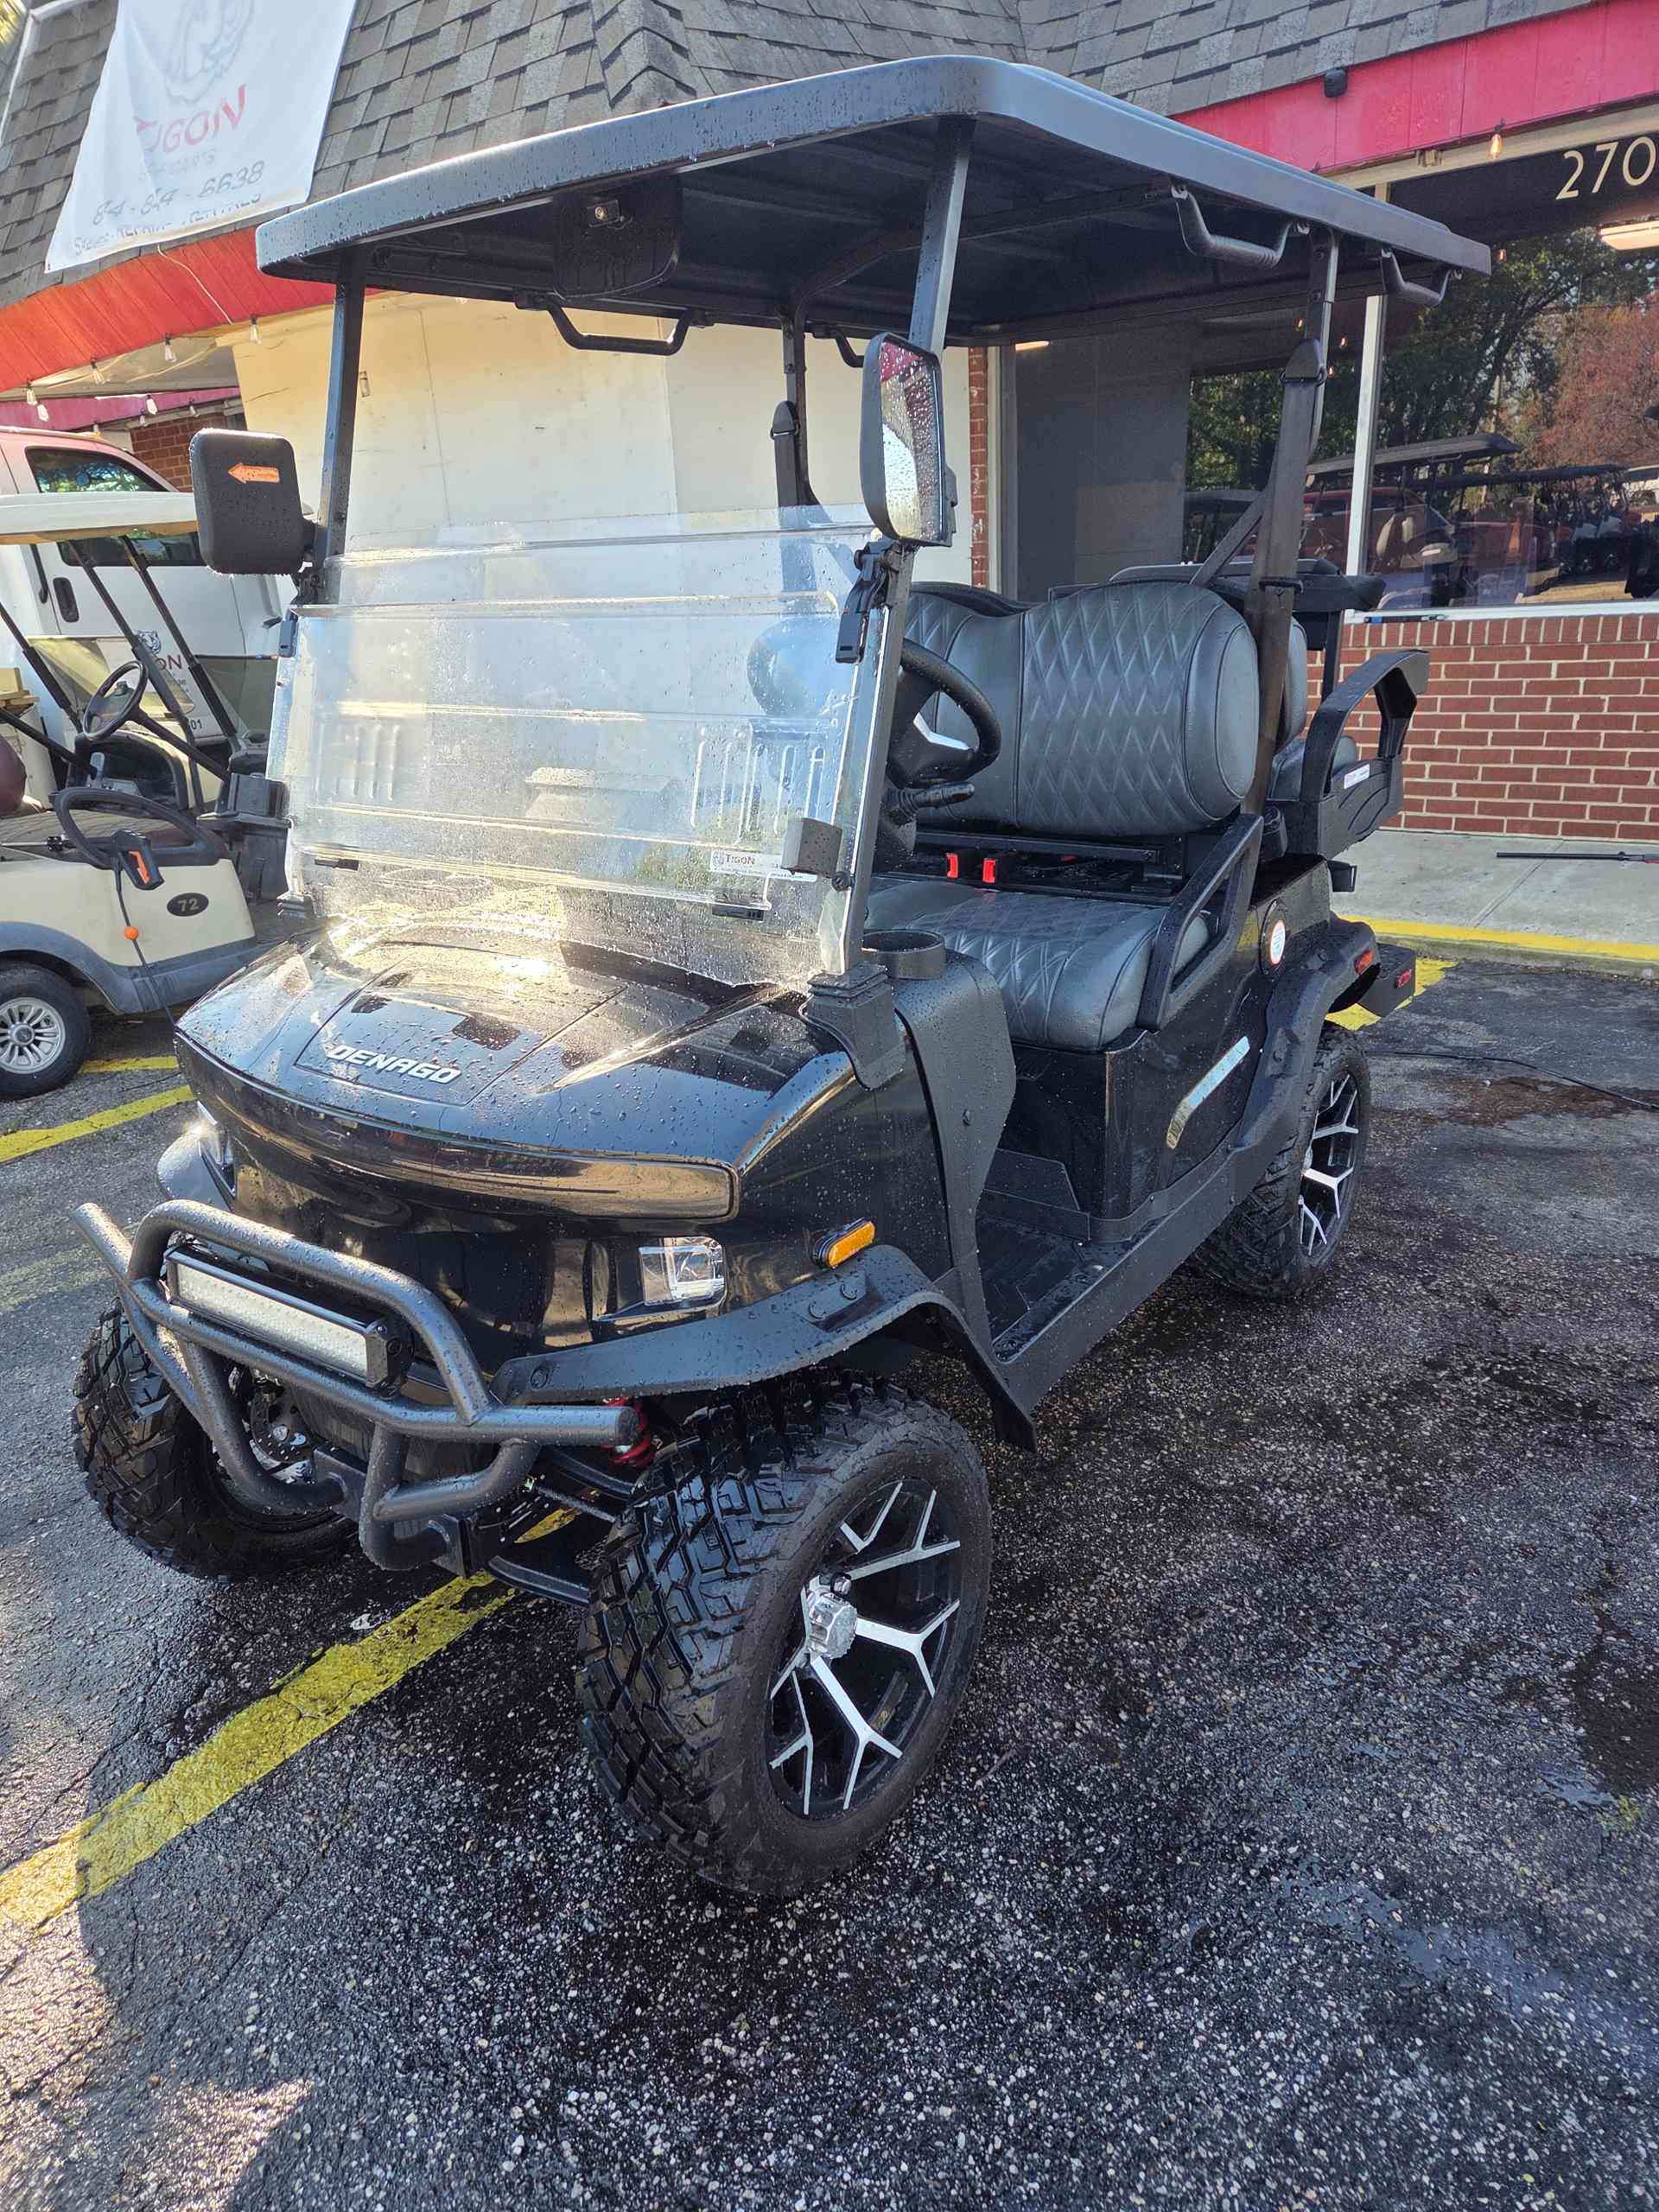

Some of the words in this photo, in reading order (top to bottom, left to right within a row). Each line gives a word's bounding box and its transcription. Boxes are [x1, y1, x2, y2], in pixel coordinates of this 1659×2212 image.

[1555, 137, 1656, 200] 270
[178, 898, 200, 912] 72
[326, 1044, 462, 1084] DENAGO
